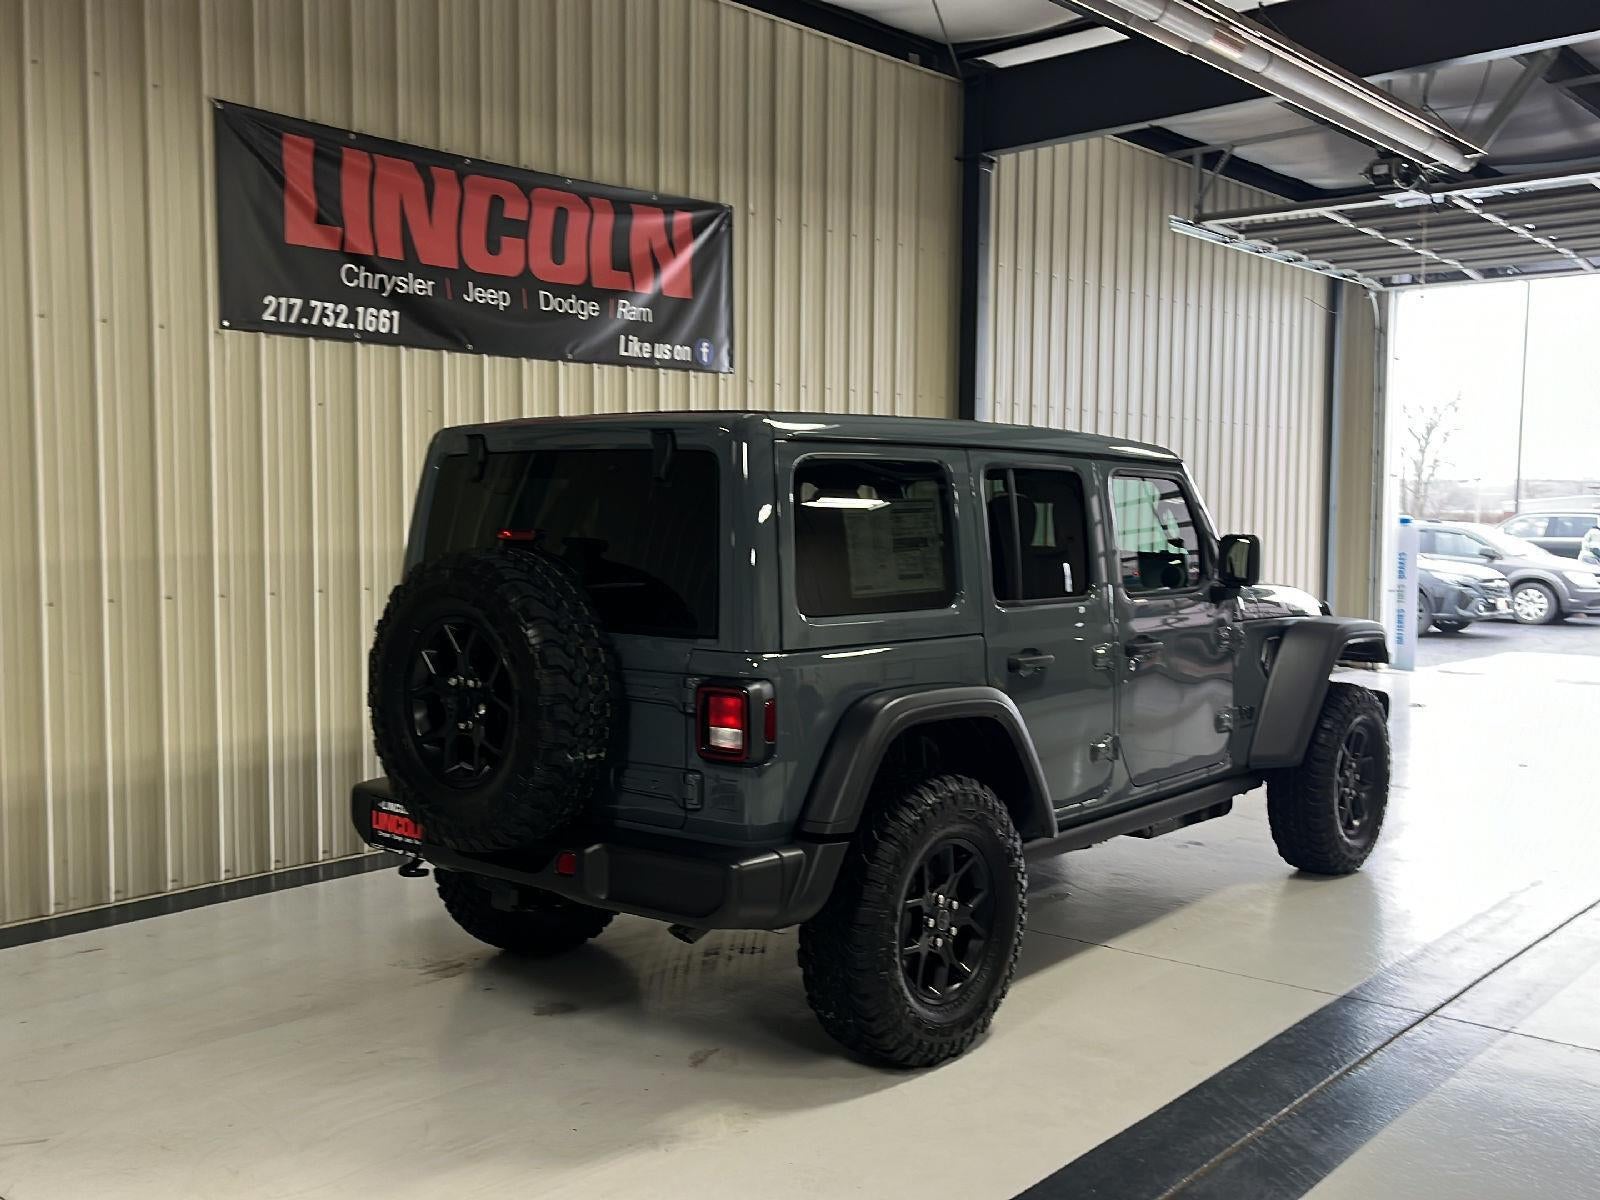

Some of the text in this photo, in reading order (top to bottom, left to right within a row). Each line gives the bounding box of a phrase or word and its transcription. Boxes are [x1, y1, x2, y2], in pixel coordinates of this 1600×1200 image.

[282, 133, 693, 299] LINCOLN
[261, 295, 401, 335] 217.732.1661
[340, 263, 653, 323] Chrysler Jeep Dodge Ram
[619, 334, 653, 358] Like
[654, 343, 673, 360] us
[673, 344, 692, 362] on
